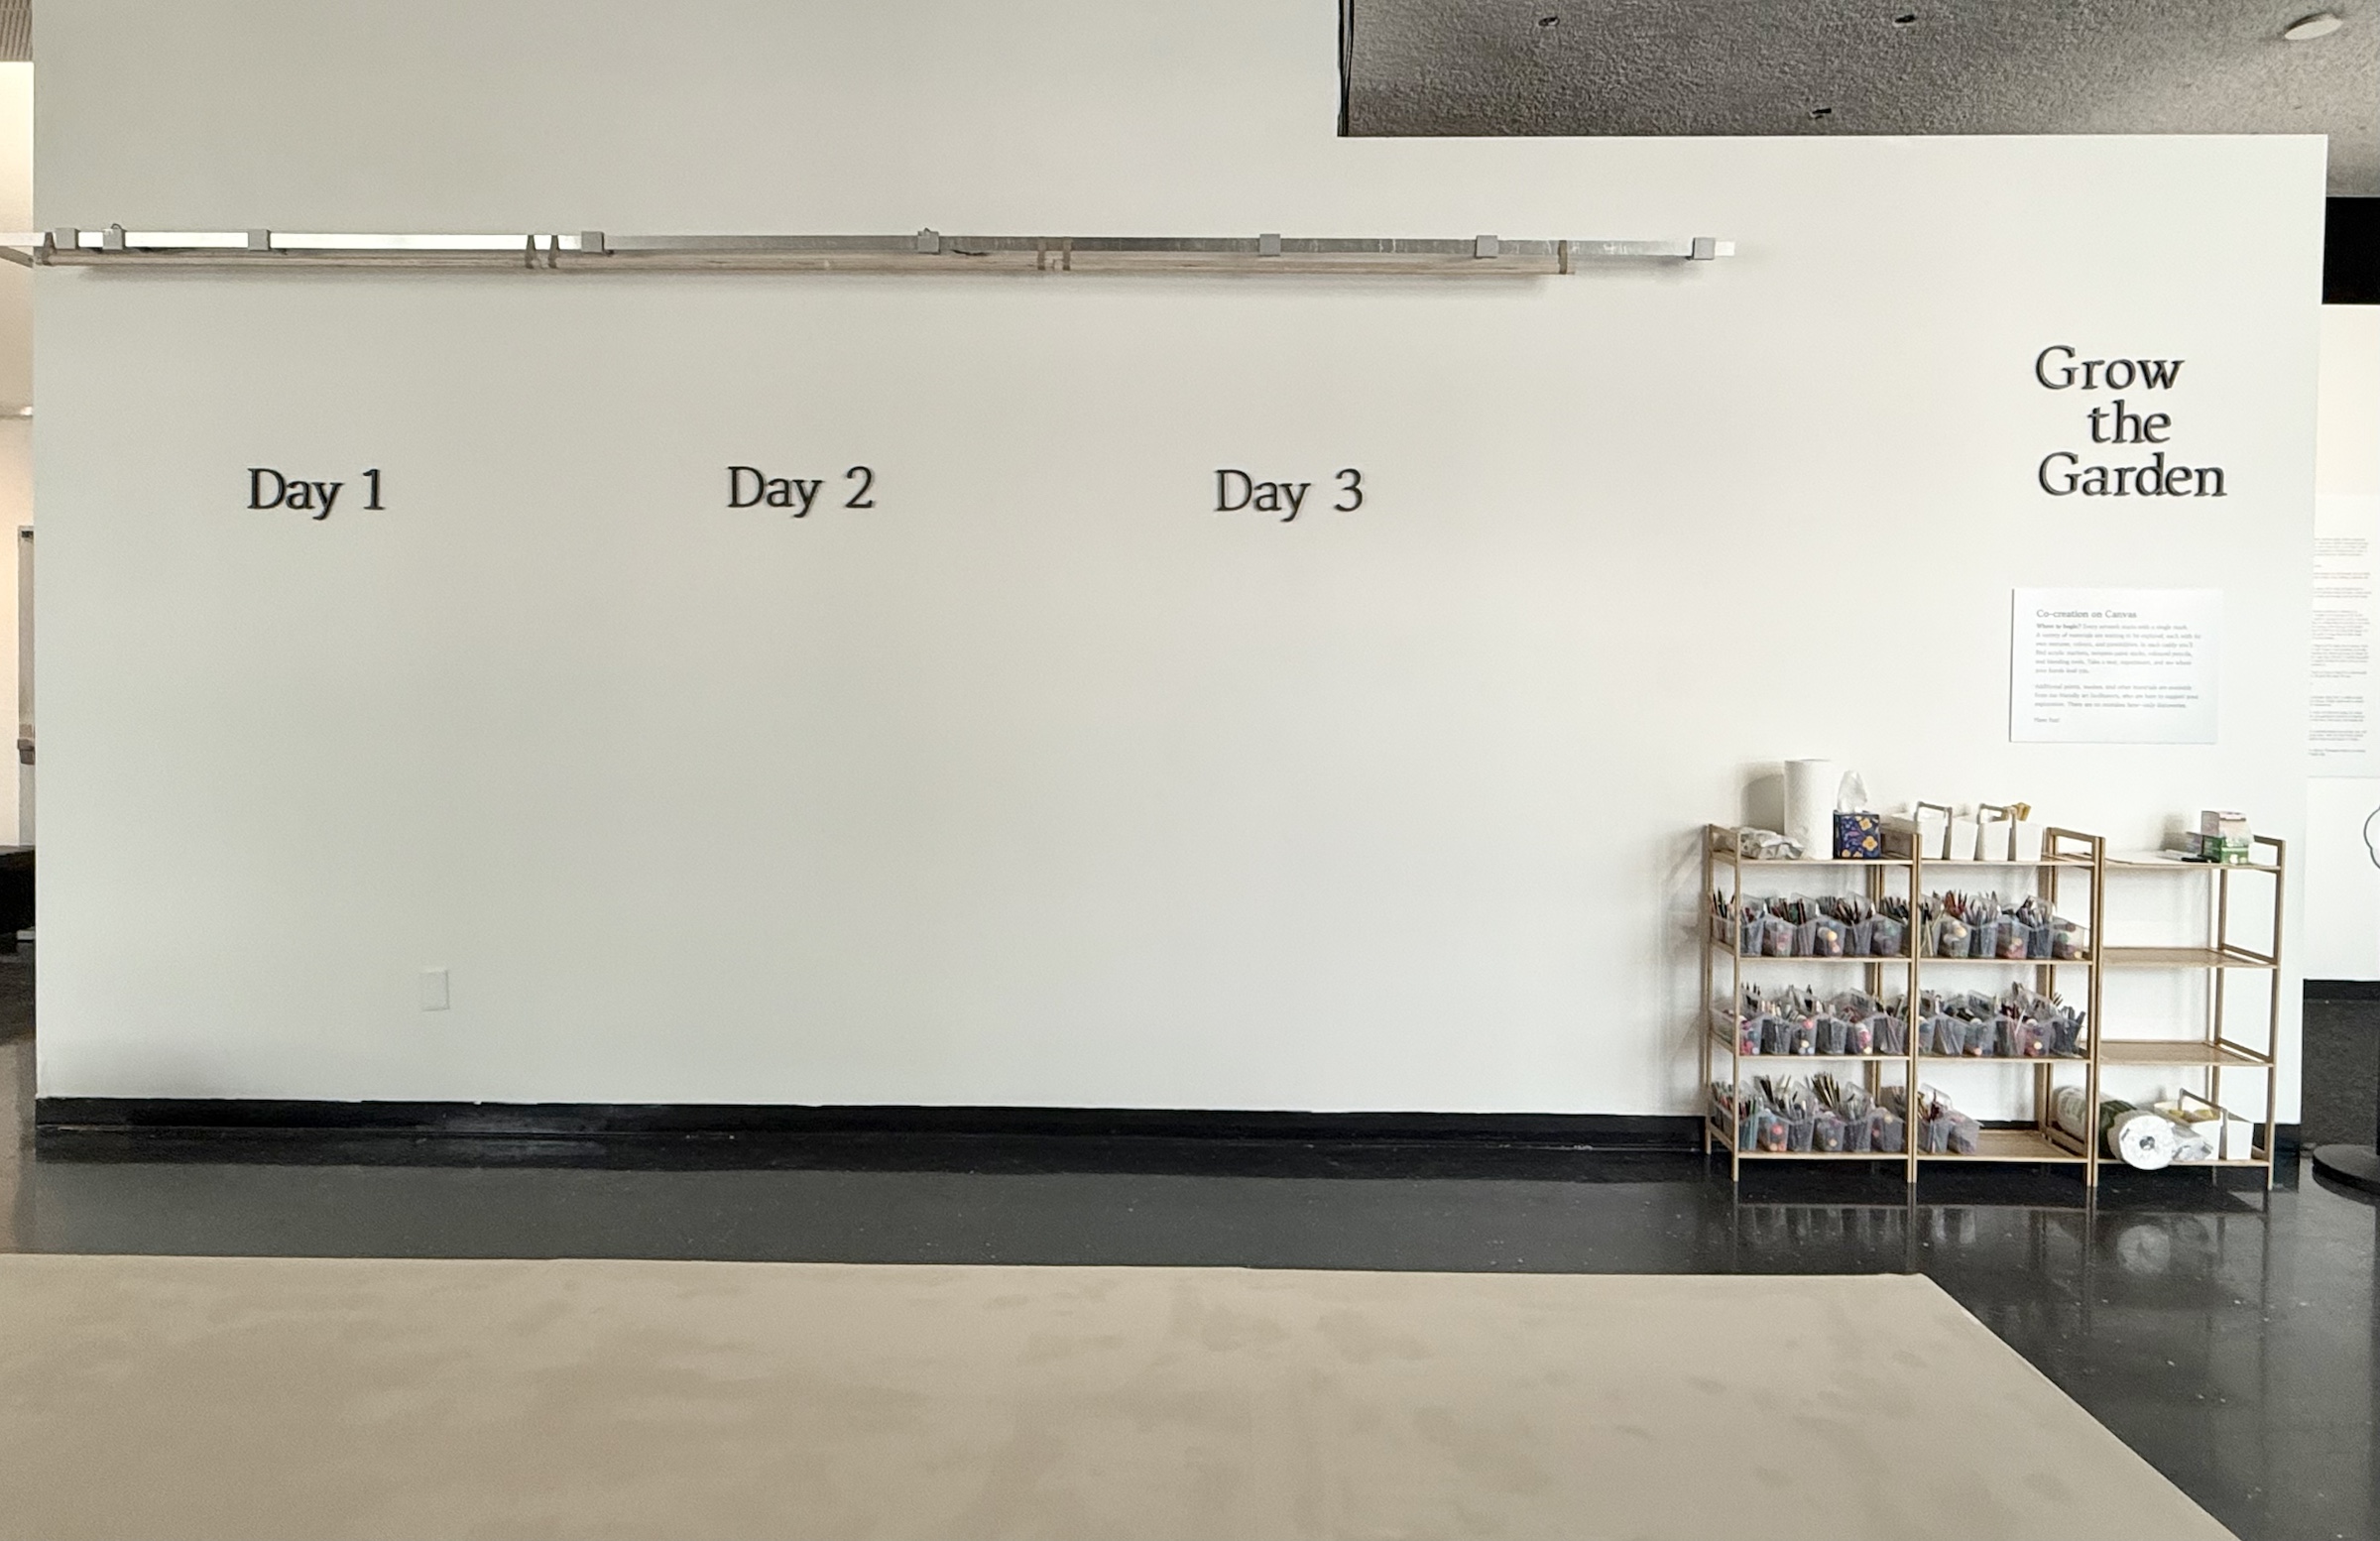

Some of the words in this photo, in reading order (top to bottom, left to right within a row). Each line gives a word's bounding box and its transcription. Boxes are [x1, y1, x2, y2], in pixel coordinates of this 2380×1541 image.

[2035, 345, 2185, 391] Grow
[2086, 399, 2172, 444] the
[246, 467, 344, 522] Day
[362, 468, 386, 511] 1
[727, 465, 825, 519] Day
[844, 465, 875, 510] 2
[1215, 468, 1312, 523] Day
[1334, 468, 1364, 513] 3
[2038, 451, 2227, 497] Garden
[2036, 609, 2088, 618] Co-creation
[2105, 609, 2137, 619] Canvas
